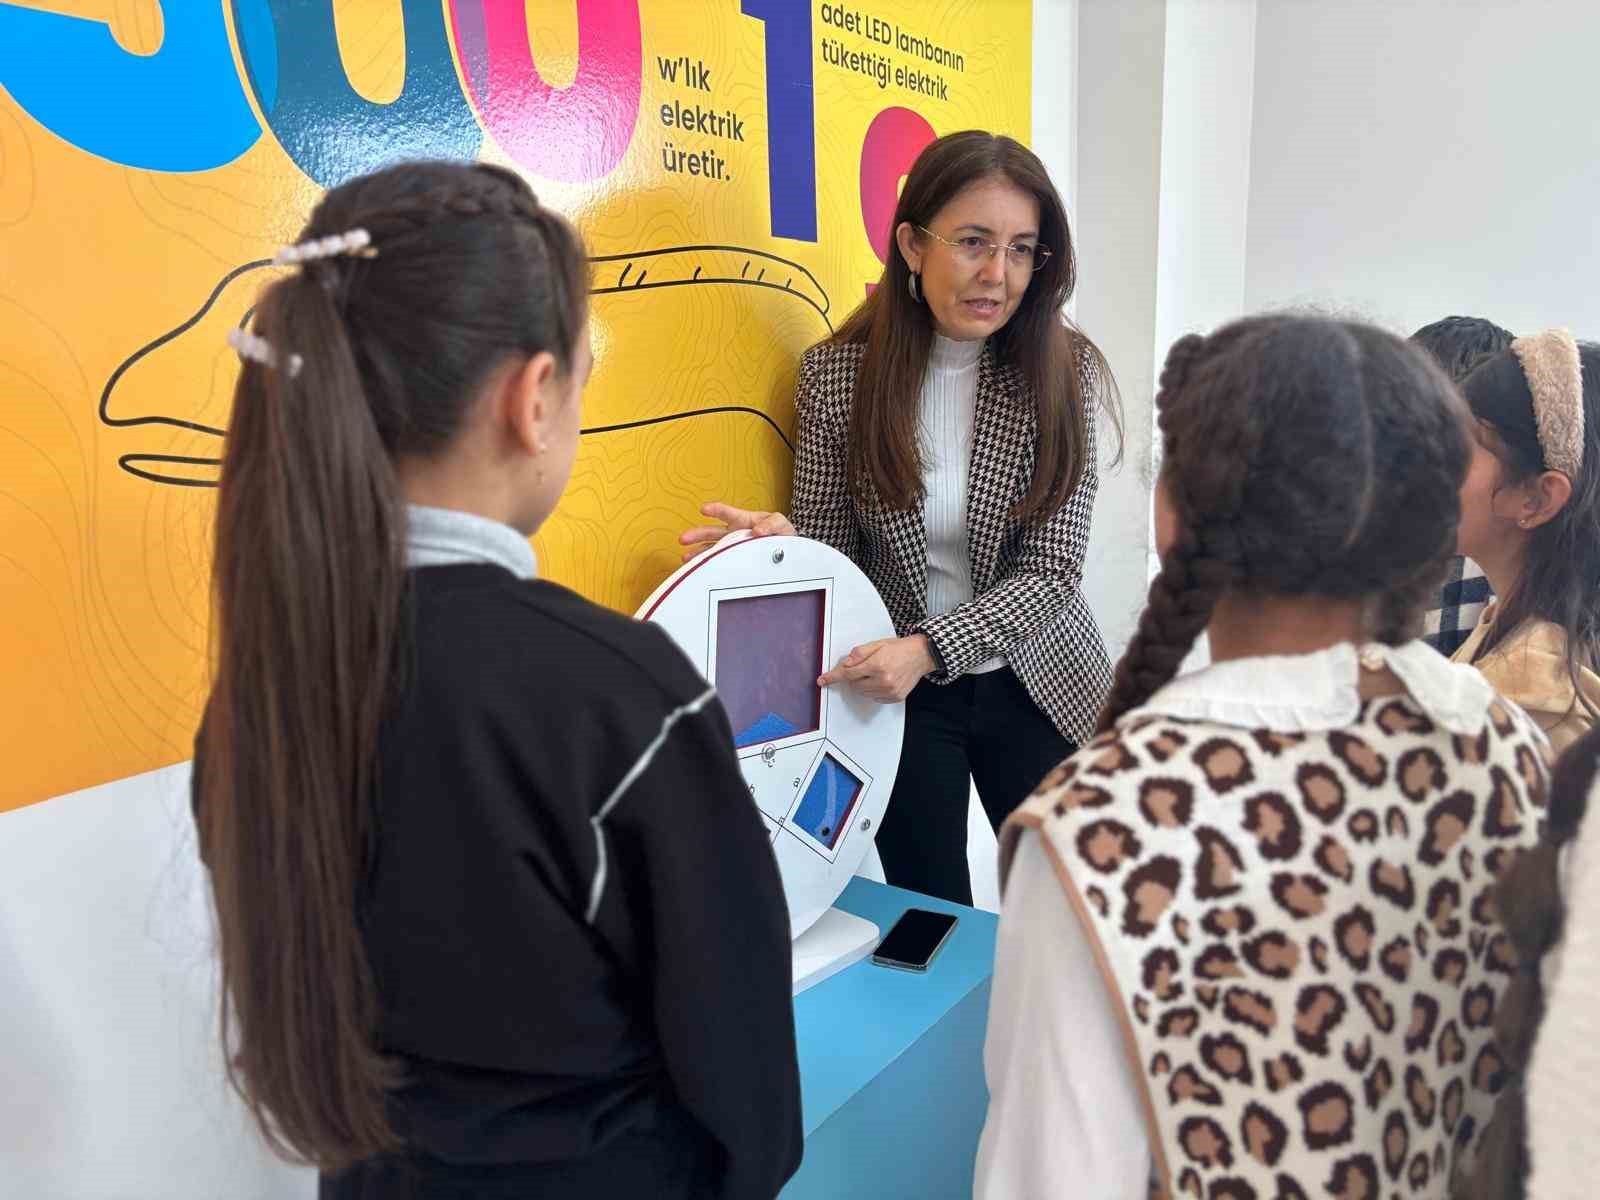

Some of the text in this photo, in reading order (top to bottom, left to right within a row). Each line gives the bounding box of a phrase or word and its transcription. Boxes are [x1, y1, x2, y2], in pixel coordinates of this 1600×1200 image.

[821, 2, 964, 73] adet LED lambanın
[657, 56, 711, 92] w'lık
[821, 37, 948, 101] tükettiği elektrik
[660, 99, 744, 142] elektrik
[663, 141, 731, 181] üretir.
